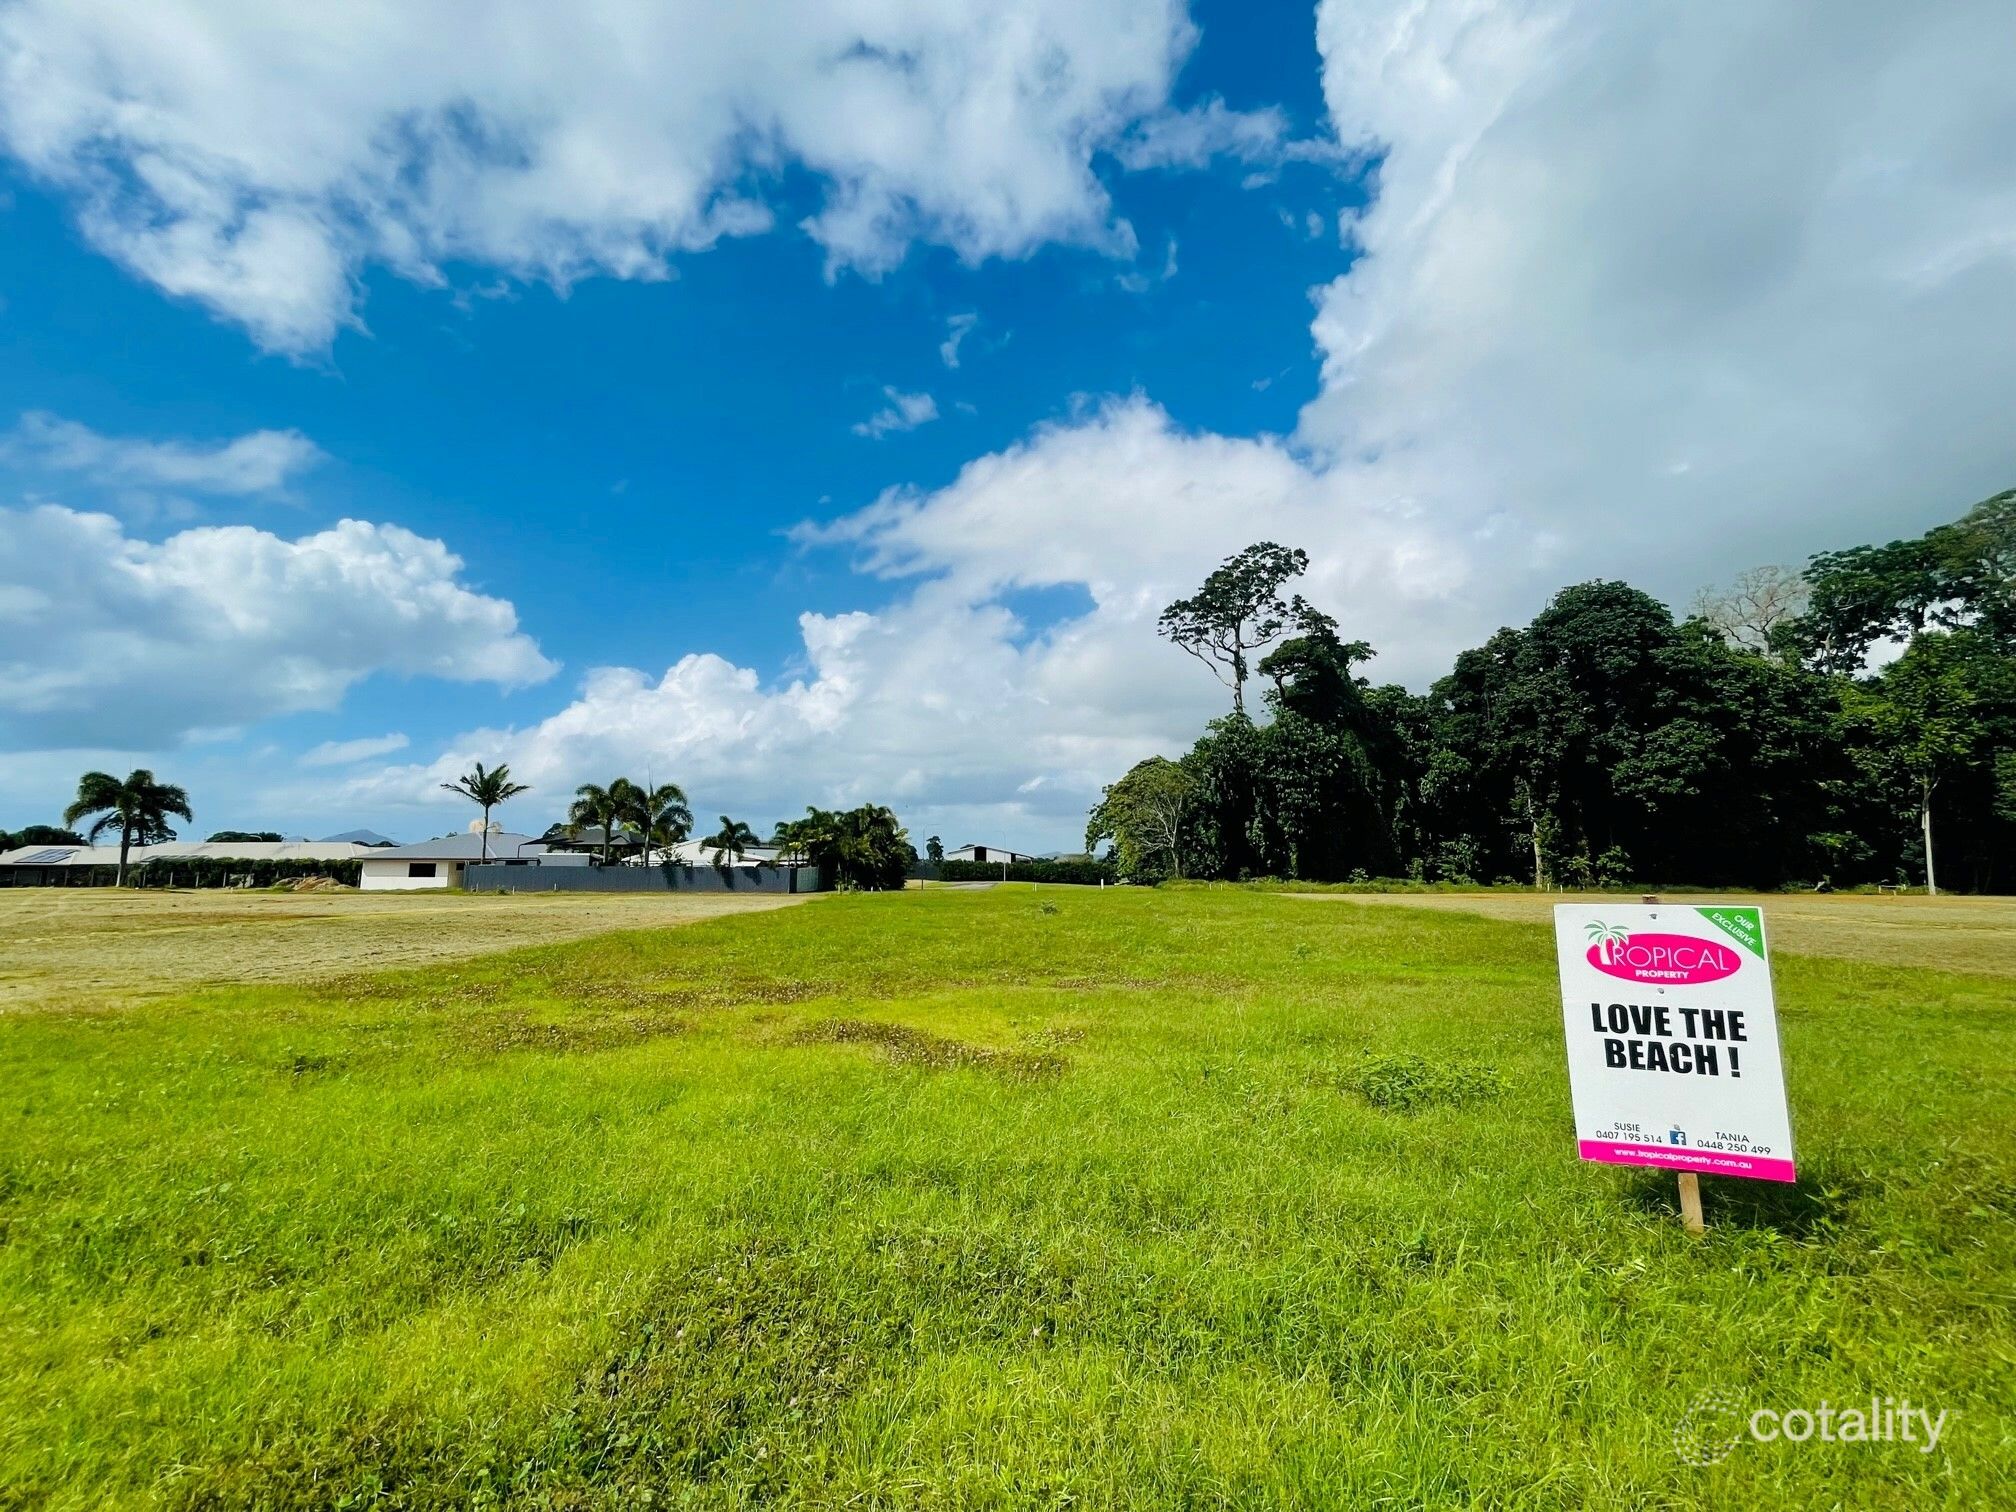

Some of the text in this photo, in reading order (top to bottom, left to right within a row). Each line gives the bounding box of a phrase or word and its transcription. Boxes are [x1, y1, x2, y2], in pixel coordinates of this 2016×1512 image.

[1711, 912, 1756, 946] EXCLUSIVE
[1734, 913, 1754, 931] OUR
[1635, 969, 1689, 979] PROPERTY
[1591, 1003, 1748, 1042] LOVE THE
[1603, 1038, 1741, 1078] BEACH !
[1614, 1122, 1641, 1132] SUSIE
[1596, 1130, 1662, 1144] 0407 195 514
[1715, 1131, 1750, 1143] TANIA
[1697, 1139, 1771, 1155] 0448 250 499
[1614, 1148, 1752, 1169] www.tropicalproperty.com.au
